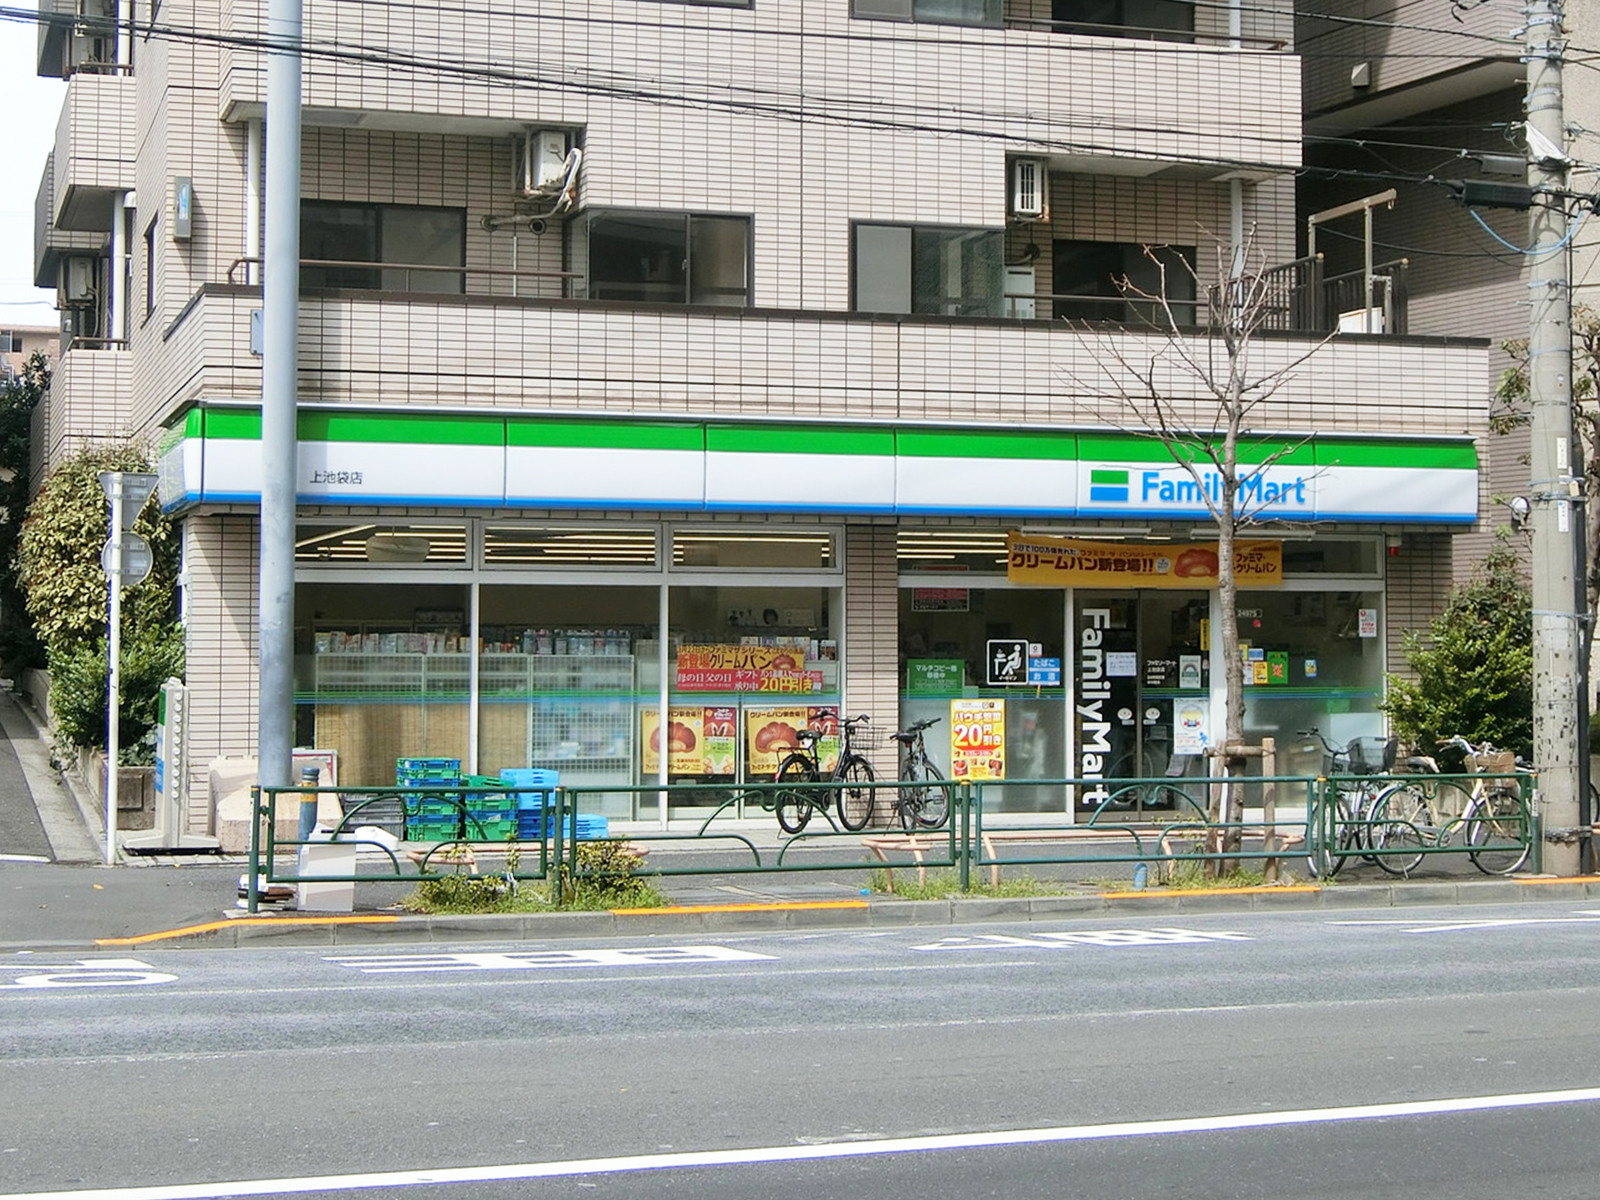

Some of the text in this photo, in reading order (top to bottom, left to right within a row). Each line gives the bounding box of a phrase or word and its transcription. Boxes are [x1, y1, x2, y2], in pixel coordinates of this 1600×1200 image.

[309, 469, 364, 485] 上池袋店
[1142, 471, 1306, 504] FamilMart
